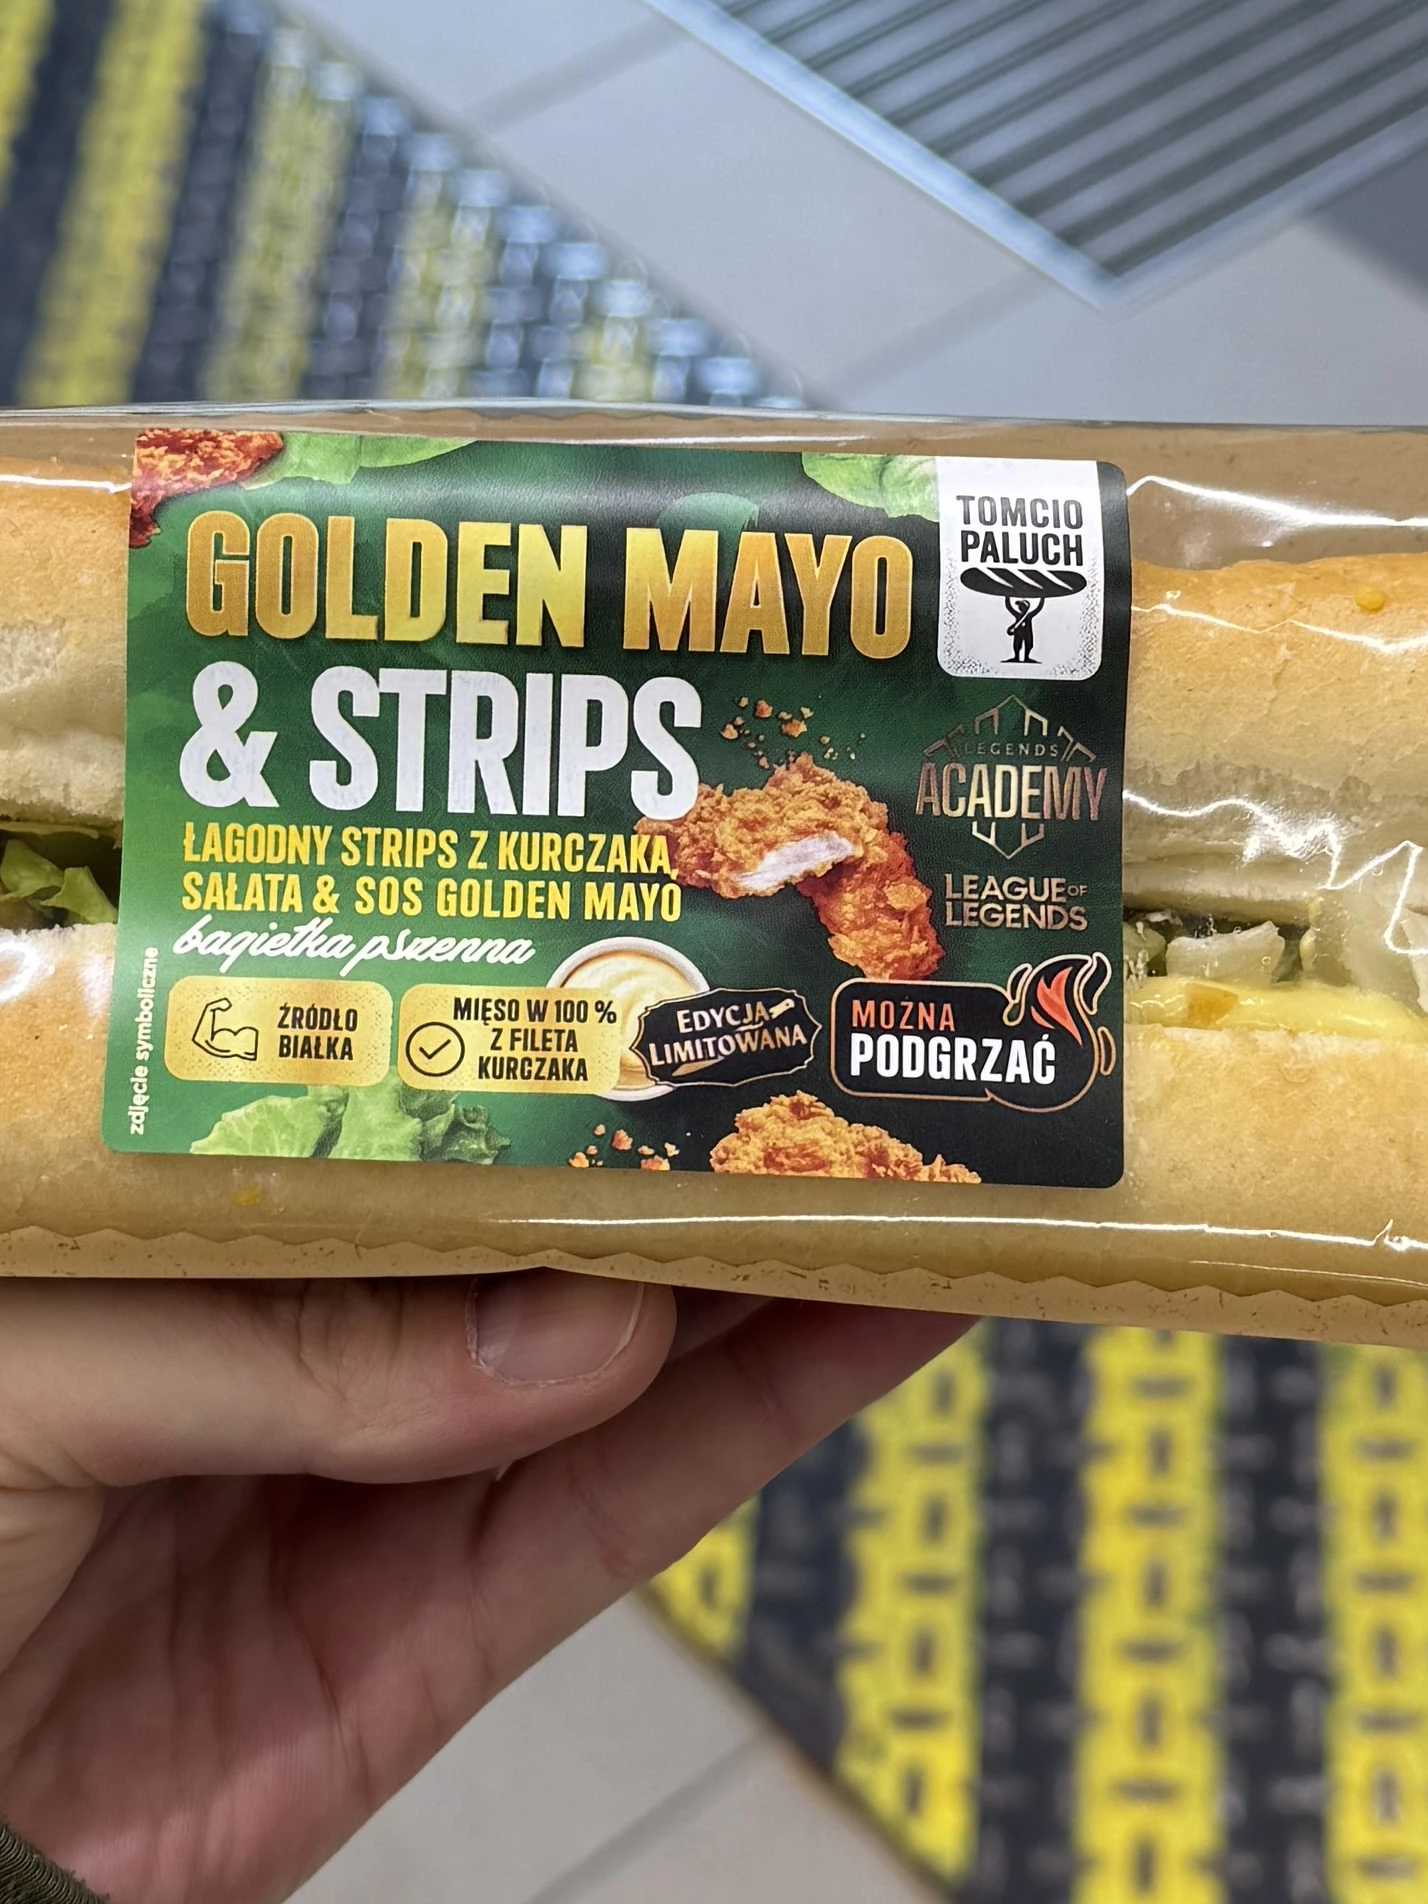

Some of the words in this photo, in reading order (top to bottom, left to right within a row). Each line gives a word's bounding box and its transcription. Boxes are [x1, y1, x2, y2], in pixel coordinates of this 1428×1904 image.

[956, 495, 1083, 529] TOMCIO
[960, 530, 1083, 566] PALUCH
[185, 510, 588, 647] GOLDEN
[624, 527, 914, 661] MAYO
[179, 660, 280, 809] &
[309, 665, 703, 821] STRIPS
[965, 743, 1059, 757] LEGENDS
[915, 763, 1107, 821] ACADEMY
[183, 822, 329, 865] ŁAGODNY
[341, 826, 457, 868] STRIPS
[468, 830, 487, 869] Z
[499, 831, 679, 880] KURCZAKA,
[182, 871, 302, 913] SAŁATA
[314, 875, 339, 913] &
[354, 876, 422, 917] SOS
[436, 878, 569, 920] GOLDEN
[583, 882, 681, 922] MAYO
[945, 873, 1066, 902] LEAGUE
[1067, 884, 1088, 896] OF
[945, 901, 1088, 931] LEGENDS
[173, 914, 357, 973] bagietka
[135, 947, 159, 1062] symboliczne
[277, 1002, 358, 1032] ŹRÓDŁO
[452, 997, 519, 1026] MIĘSO
[526, 1000, 548, 1022] W
[554, 1000, 588, 1024] 100
[594, 1003, 617, 1025] %
[677, 999, 770, 1034] EDYCJA
[851, 996, 956, 1032] MOŻNA
[279, 1034, 354, 1061] BIAŁKA
[490, 1029, 503, 1052] Z
[510, 1029, 579, 1053] FILETA
[649, 1024, 808, 1065] LIMITOWANA
[850, 1033, 1056, 1085] PODGRZAĆ
[477, 1056, 589, 1082] KURCZAKA
[128, 1066, 151, 1135] zdjęcie
